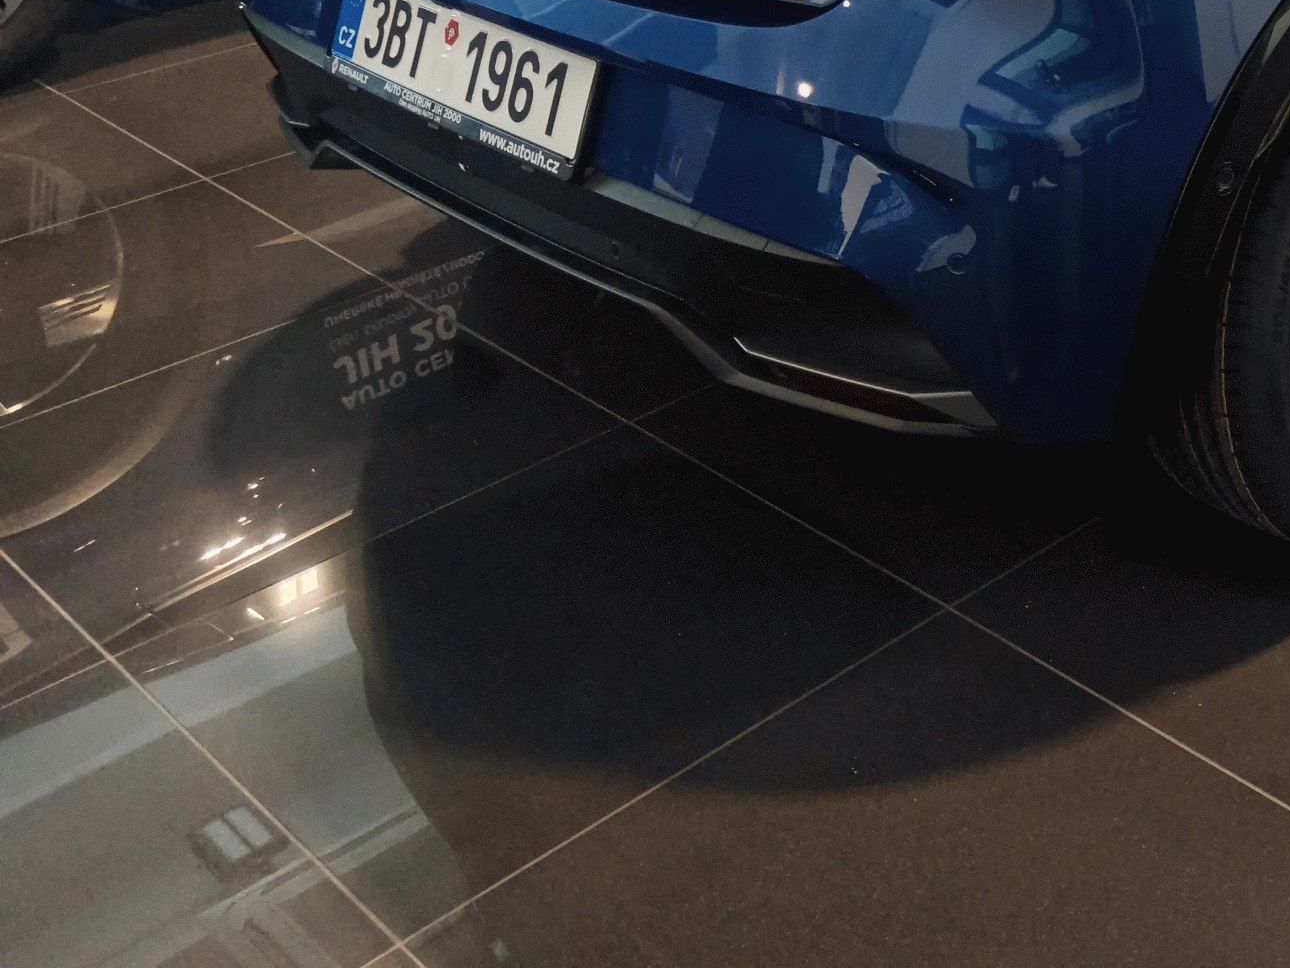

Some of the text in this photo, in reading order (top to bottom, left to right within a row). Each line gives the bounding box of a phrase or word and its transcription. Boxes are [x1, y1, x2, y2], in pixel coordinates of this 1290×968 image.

[338, 25, 356, 48] CZ
[338, 63, 369, 85] RENAULT
[465, 31, 568, 137] 1961
[383, 81, 401, 96] AUTO
[401, 88, 432, 111] CENTRUM
[443, 108, 462, 124] 2000
[479, 128, 560, 174] www.autouh.cz
